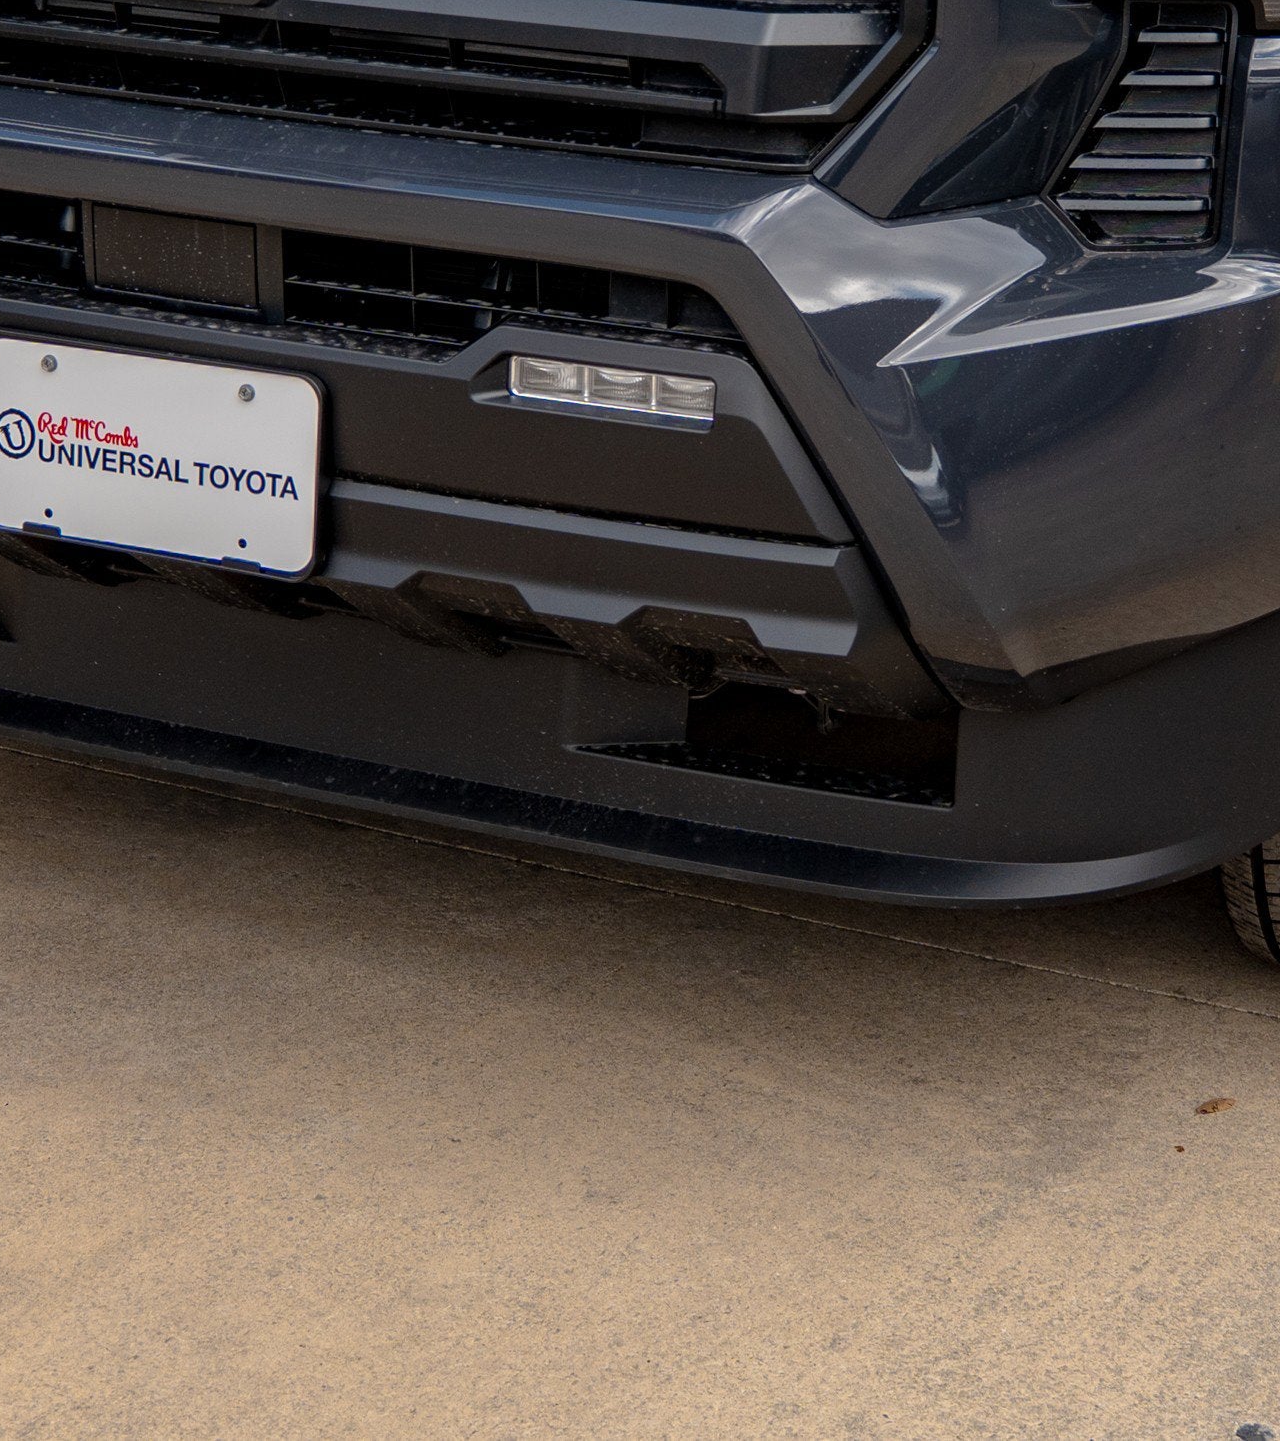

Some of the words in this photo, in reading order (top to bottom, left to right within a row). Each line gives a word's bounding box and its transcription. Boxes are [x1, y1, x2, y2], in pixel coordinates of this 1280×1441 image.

[38, 411, 68, 444] Red
[71, 416, 139, 449] McCombs
[38, 439, 189, 484] UNIVERSAL
[193, 462, 299, 500] TOYOTA
